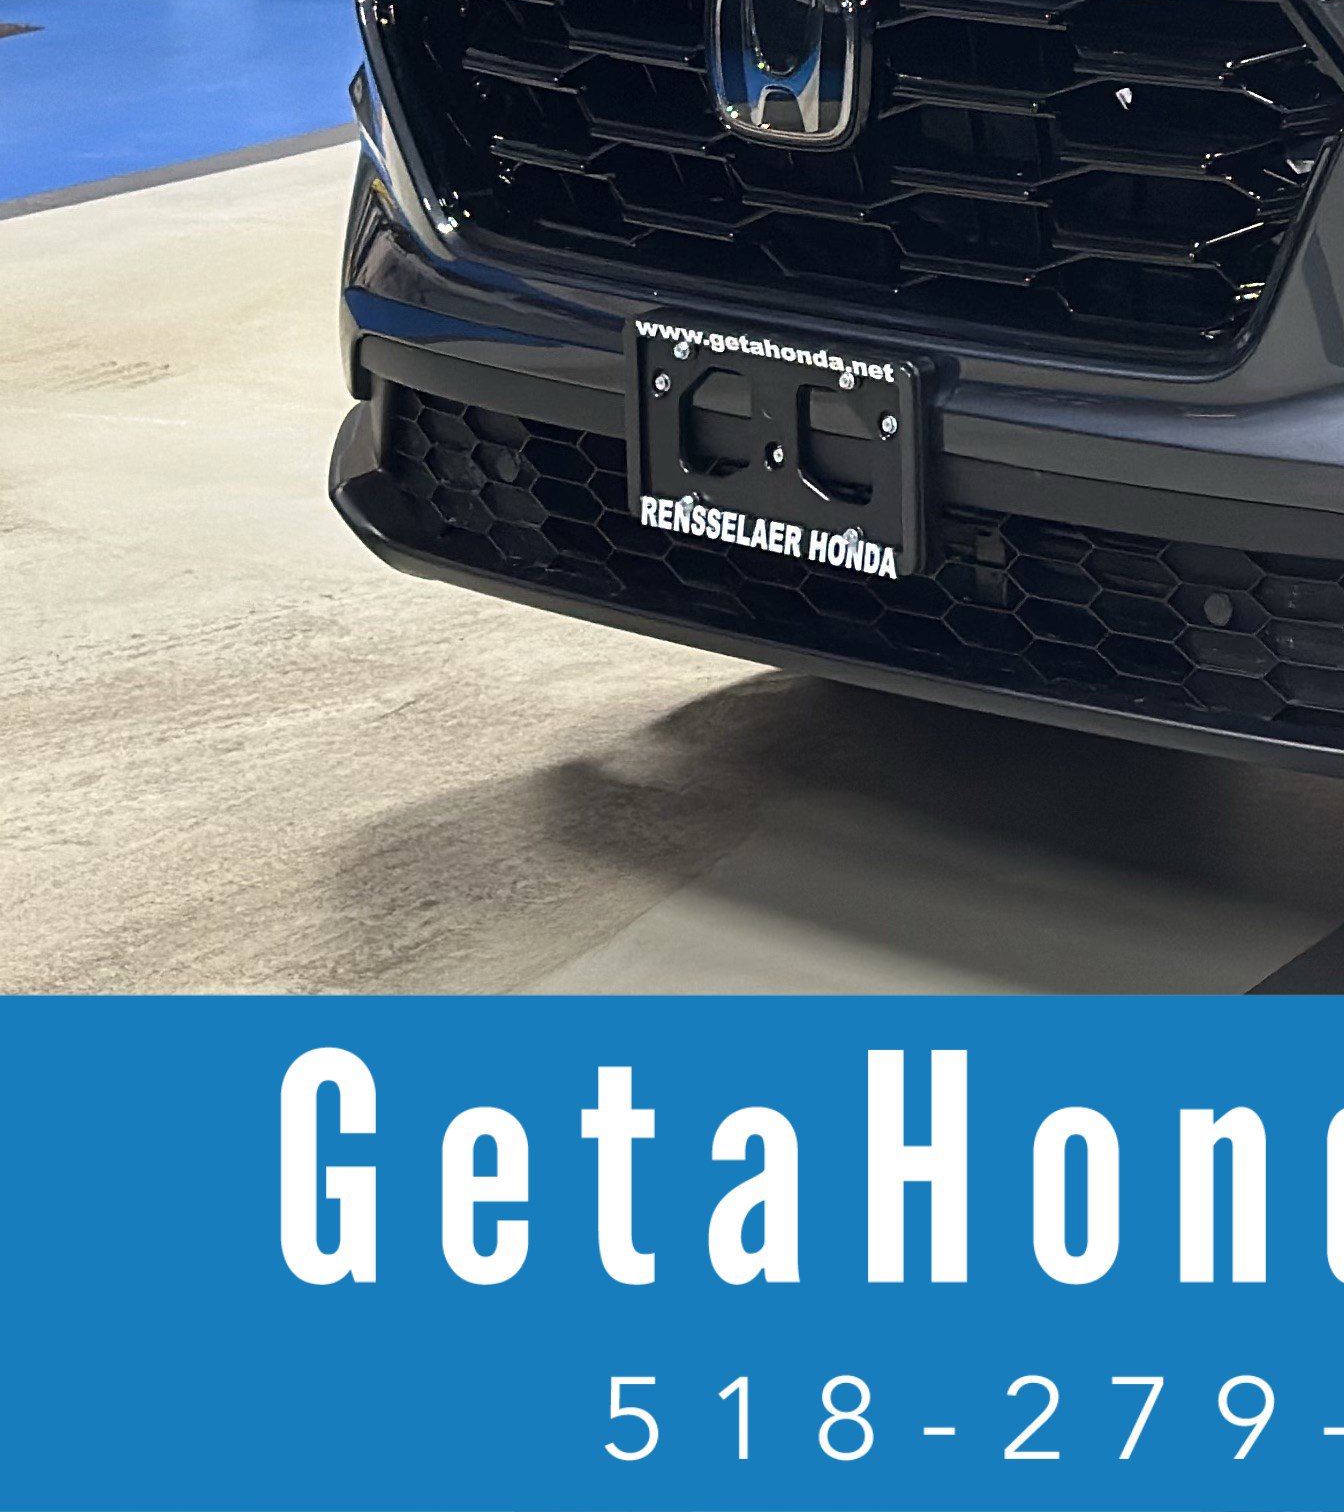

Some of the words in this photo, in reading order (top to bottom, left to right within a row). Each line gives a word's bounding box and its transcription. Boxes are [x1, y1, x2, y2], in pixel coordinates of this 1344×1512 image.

[635, 320, 895, 383] www.getahonda.net
[640, 495, 801, 557] RENSSELAER
[808, 529, 898, 580] HONDA
